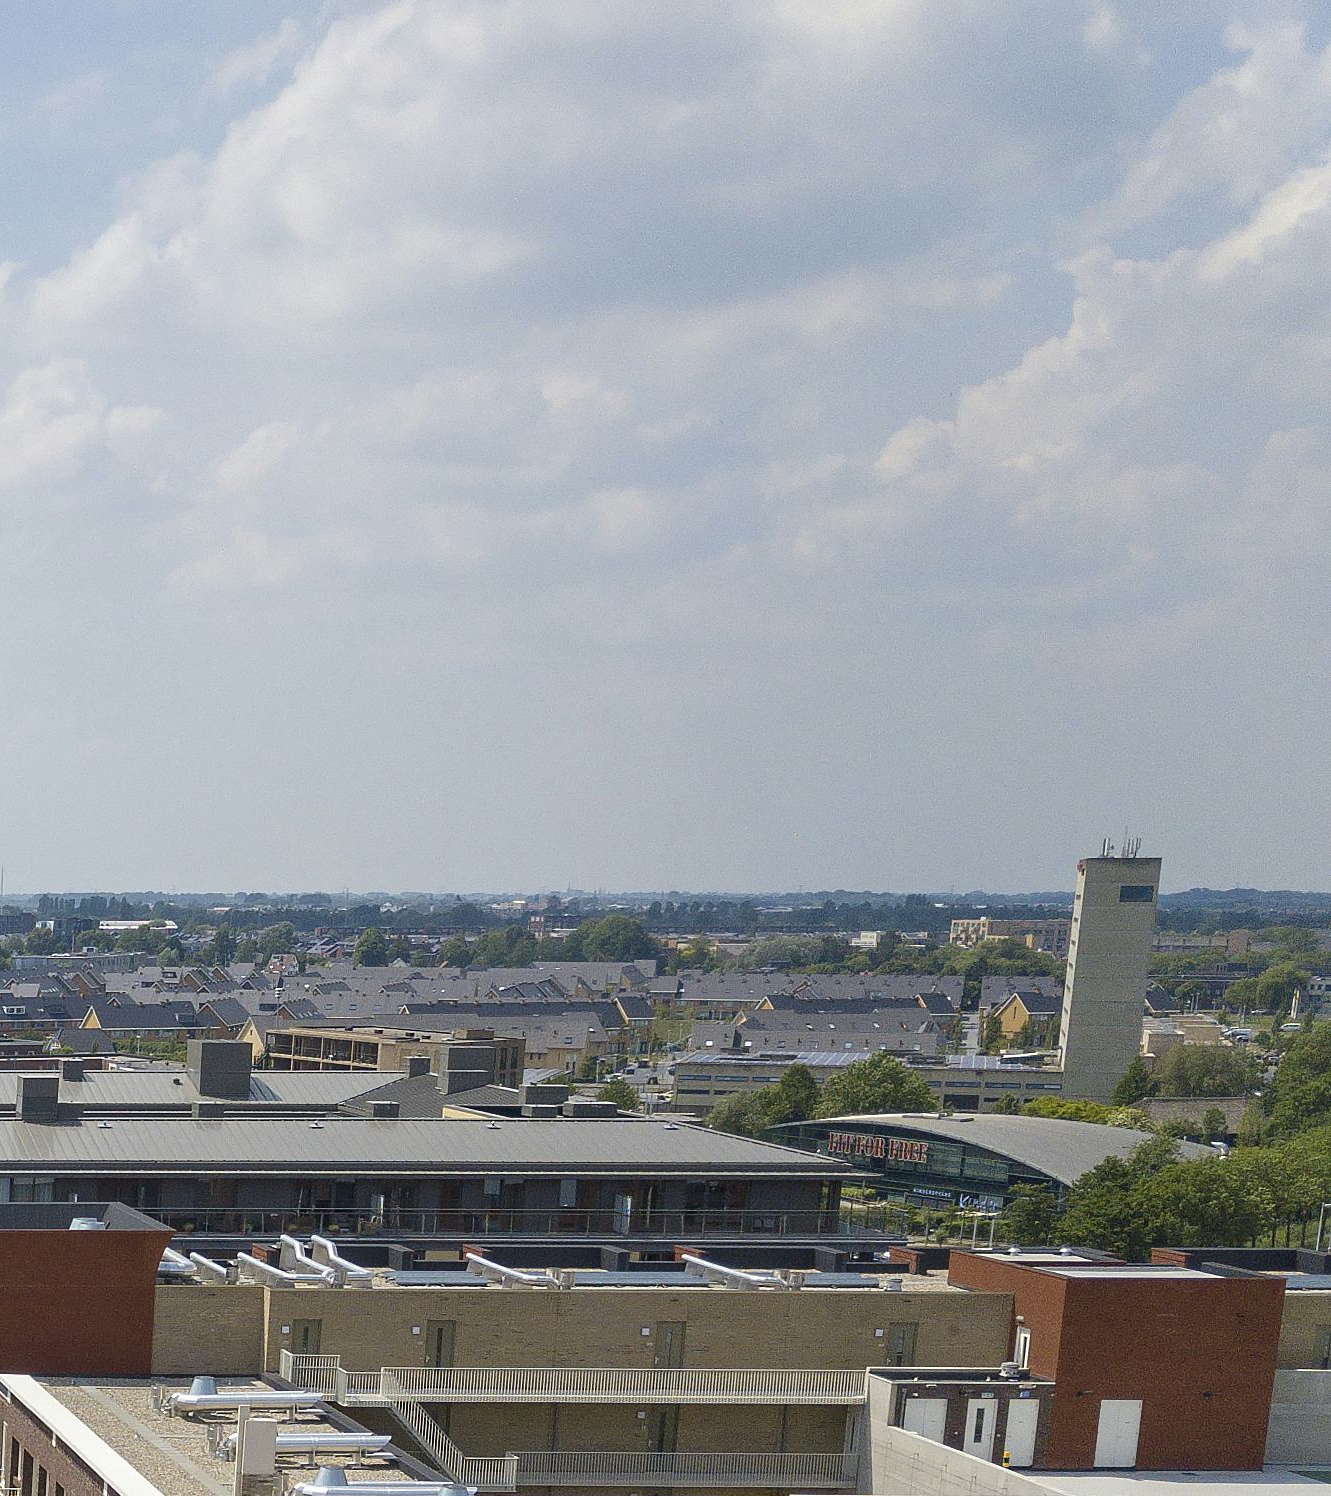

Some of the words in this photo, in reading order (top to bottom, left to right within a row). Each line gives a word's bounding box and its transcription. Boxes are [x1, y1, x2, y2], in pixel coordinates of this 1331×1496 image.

[828, 1132, 855, 1153] FIT
[855, 1134, 886, 1158] FOR
[888, 1137, 929, 1163] FREE
